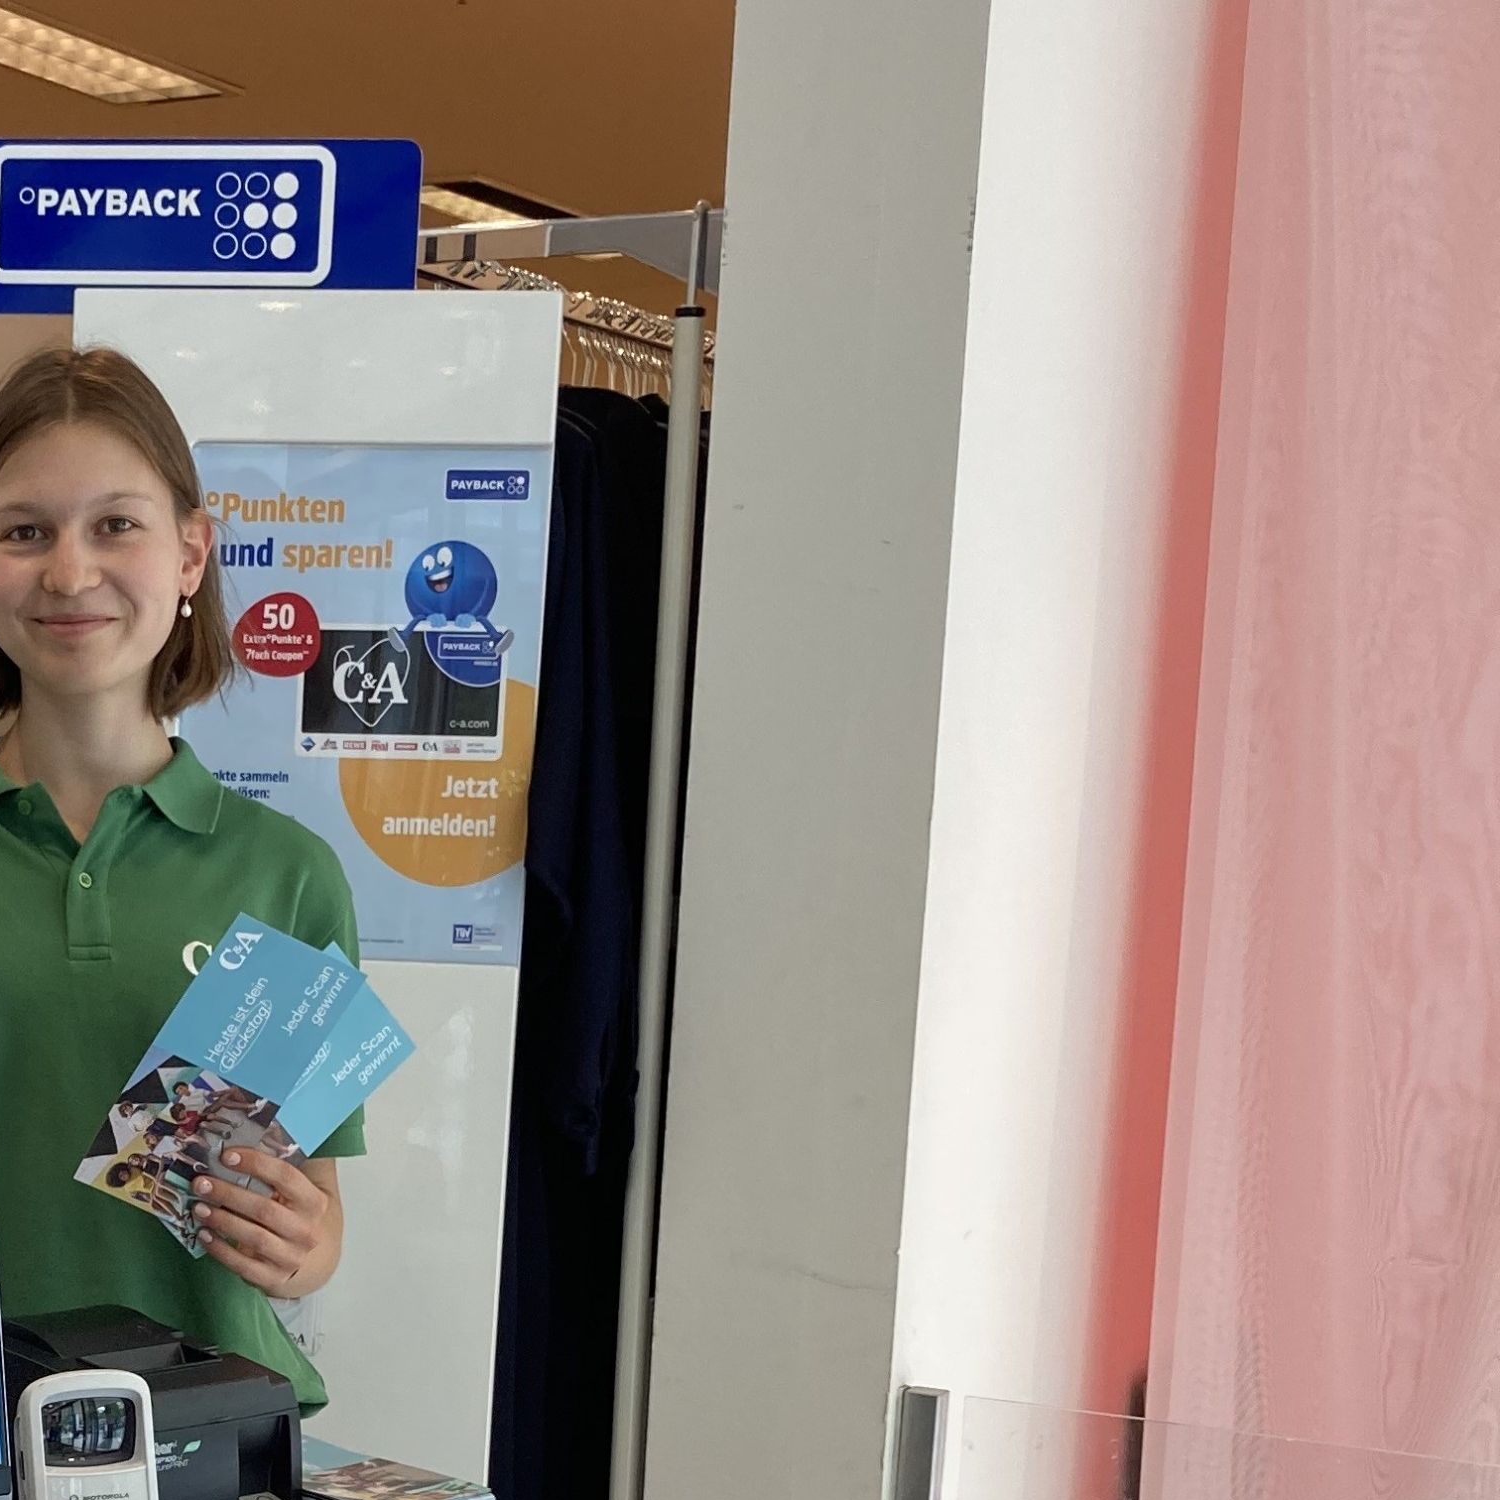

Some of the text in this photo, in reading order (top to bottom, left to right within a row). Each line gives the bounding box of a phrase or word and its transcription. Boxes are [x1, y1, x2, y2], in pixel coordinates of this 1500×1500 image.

[450, 479, 505, 491] PAYBACK
[220, 537, 393, 573] und sparen!
[262, 603, 295, 631] 50
[442, 642, 481, 651] PAYBACK
[333, 661, 409, 705] C&A
[449, 719, 490, 729] c-a.com
[240, 771, 289, 783] sammeln
[442, 775, 499, 799] Jetzt
[382, 813, 496, 837] anmelden!
[218, 930, 263, 971] C&A
[281, 965, 334, 1036] Jeder Scan
[311, 971, 349, 1027] gewinnt
[204, 977, 268, 1063] Heute ist dein
[331, 1052, 361, 1087] Jeder
[360, 1025, 392, 1055] Scan
[357, 1035, 402, 1086] gewinnt
